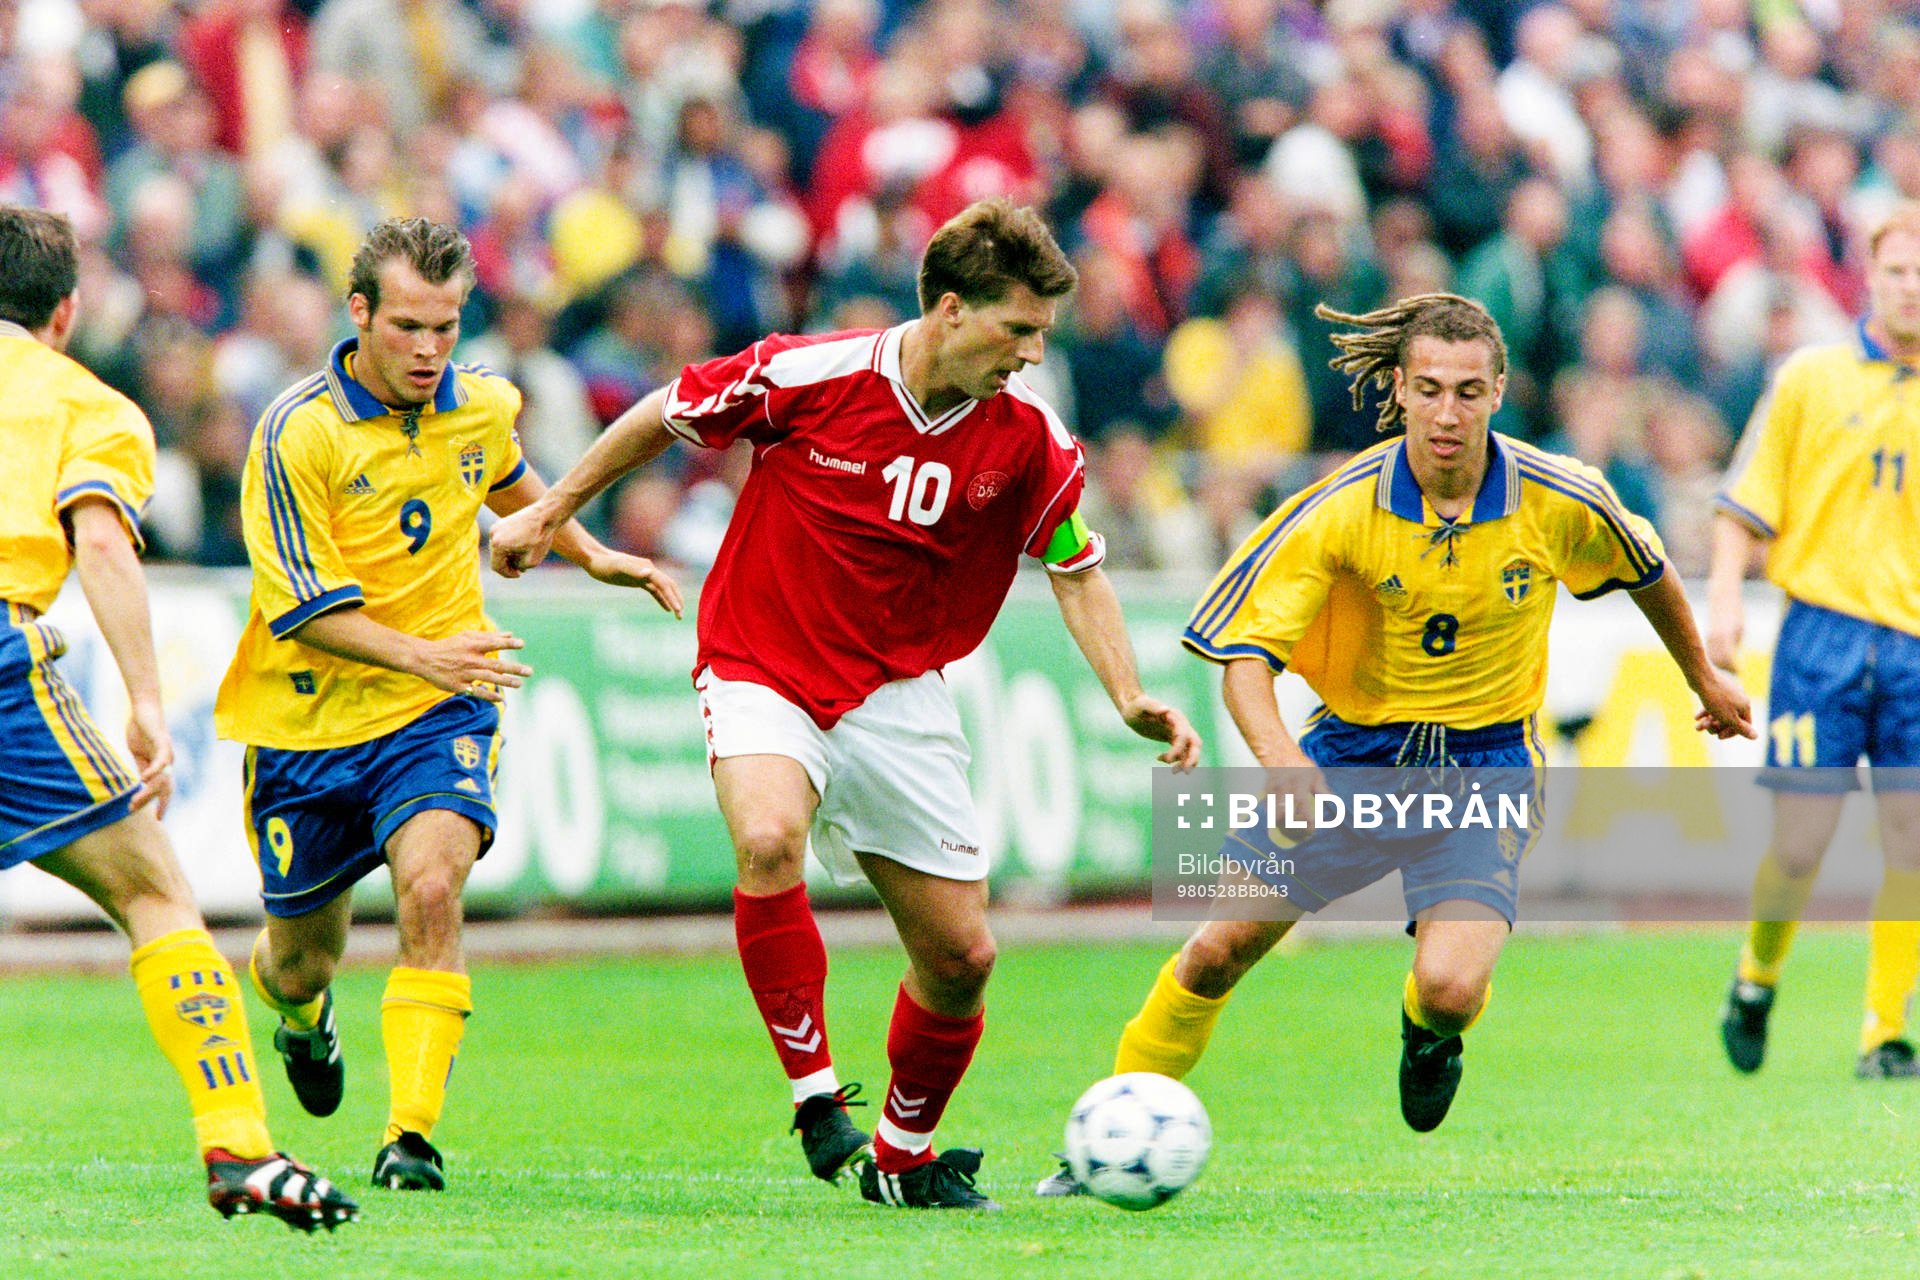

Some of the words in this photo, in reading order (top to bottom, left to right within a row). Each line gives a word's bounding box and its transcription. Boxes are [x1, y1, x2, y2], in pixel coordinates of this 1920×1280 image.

[809, 448, 867, 475] hummel
[1871, 447, 1905, 493] 11
[881, 455, 952, 526] 10
[400, 498, 432, 556] 9
[1421, 613, 1460, 657] 8
[1770, 711, 1817, 768] 11
[267, 816, 294, 879] 9
[940, 838, 980, 856] hummel
